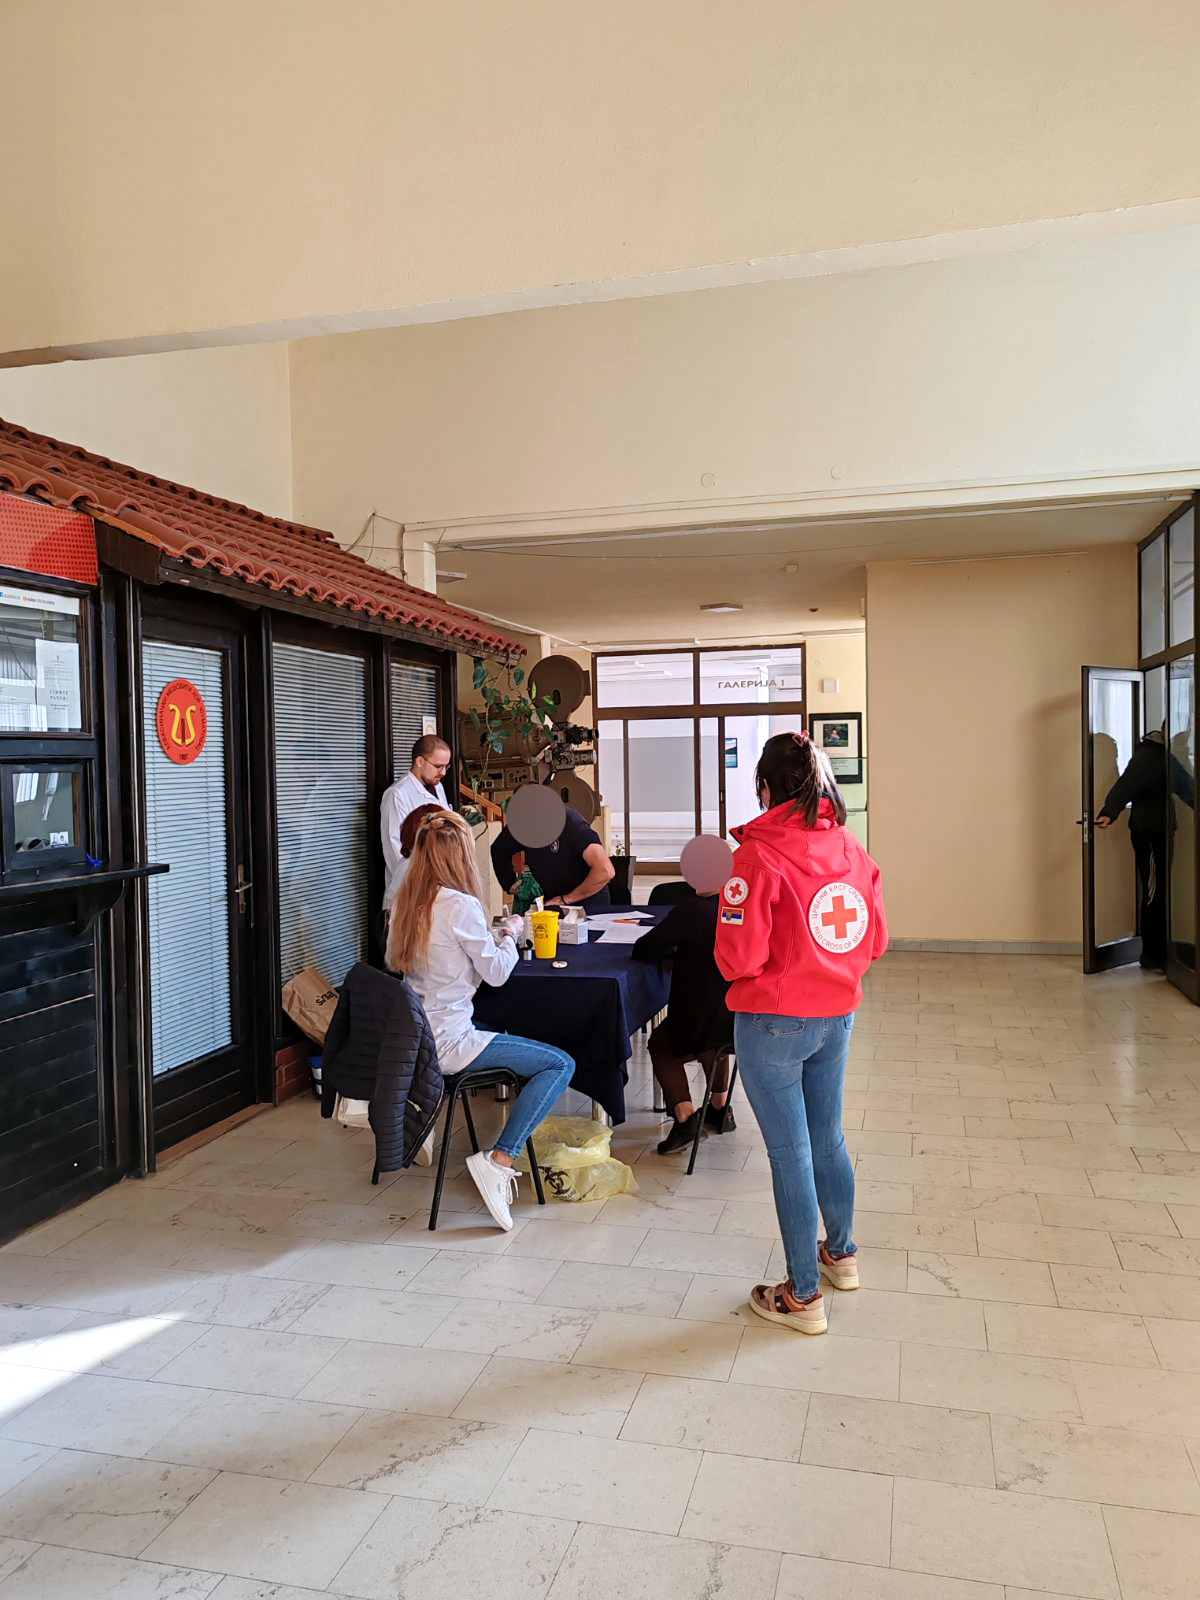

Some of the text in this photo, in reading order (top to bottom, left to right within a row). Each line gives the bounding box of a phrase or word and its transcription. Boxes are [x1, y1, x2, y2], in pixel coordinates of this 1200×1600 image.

[718, 679, 776, 689] ГАЛЕРИЈА
[812, 884, 866, 919] ЦРВЕНИ КРСТ СРБИЈЕ
[813, 919, 866, 951] RED CROSS OF SERBIA
